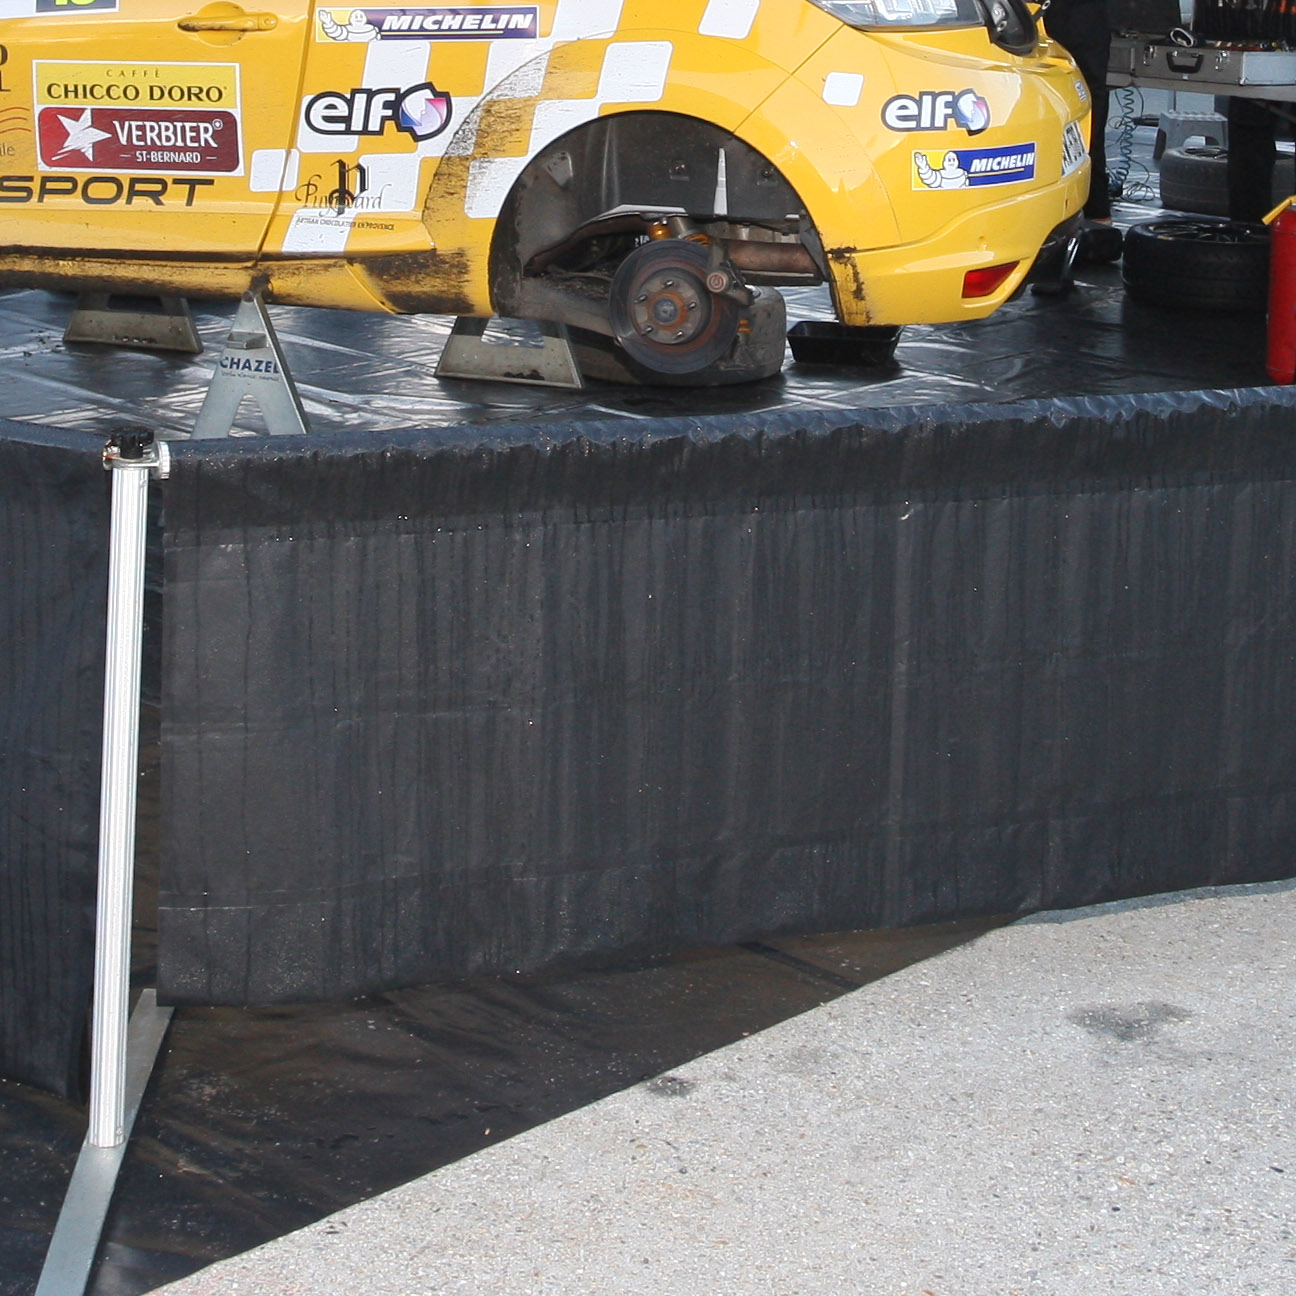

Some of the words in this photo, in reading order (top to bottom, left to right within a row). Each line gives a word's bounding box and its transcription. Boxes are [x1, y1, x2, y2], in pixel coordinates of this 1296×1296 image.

[380, 15, 532, 31] MICHELIN
[46, 82, 140, 102] CHICCO
[148, 83, 223, 103] D'ORO
[309, 91, 398, 133] elf
[884, 96, 954, 130] elf
[112, 120, 219, 148] VERBIER
[136, 150, 201, 164] ST-BERNARD
[969, 152, 1036, 173] MICHELIN
[220, 355, 281, 374] CHAZEL
